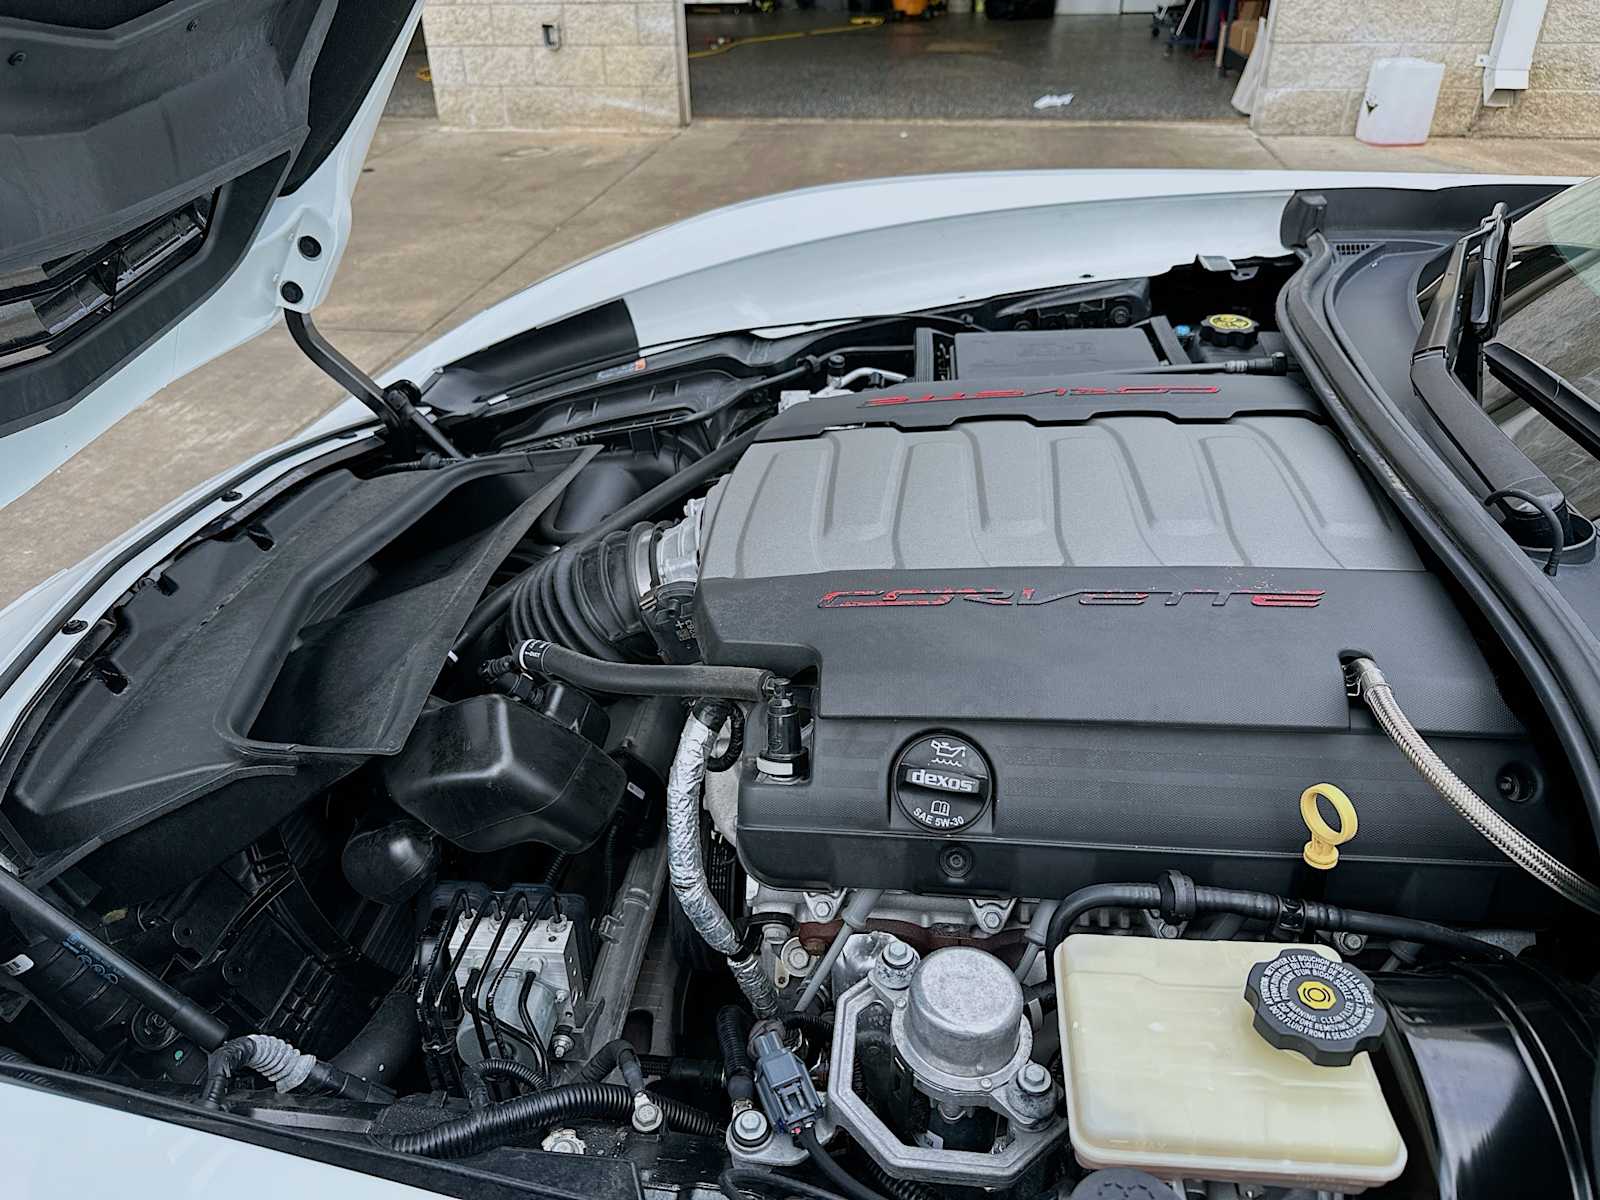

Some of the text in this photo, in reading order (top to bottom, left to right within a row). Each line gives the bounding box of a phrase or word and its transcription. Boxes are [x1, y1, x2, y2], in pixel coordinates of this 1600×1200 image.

[817, 586, 1326, 608] CORVETTE
[911, 769, 976, 792] dexos
[913, 807, 965, 828] SAE 5W-30
[1287, 955, 1298, 963] LE
[1297, 954, 1330, 966] BOUCHON
[1329, 962, 1353, 977] AVANT
[1349, 974, 1361, 985] LA
[1327, 967, 1338, 977] DE
[1277, 1002, 1291, 1013] CAP
[1287, 1010, 1315, 1029] BEFORE
[1282, 1017, 1304, 1032] FLUID
[1303, 1027, 1325, 1039] FROM
